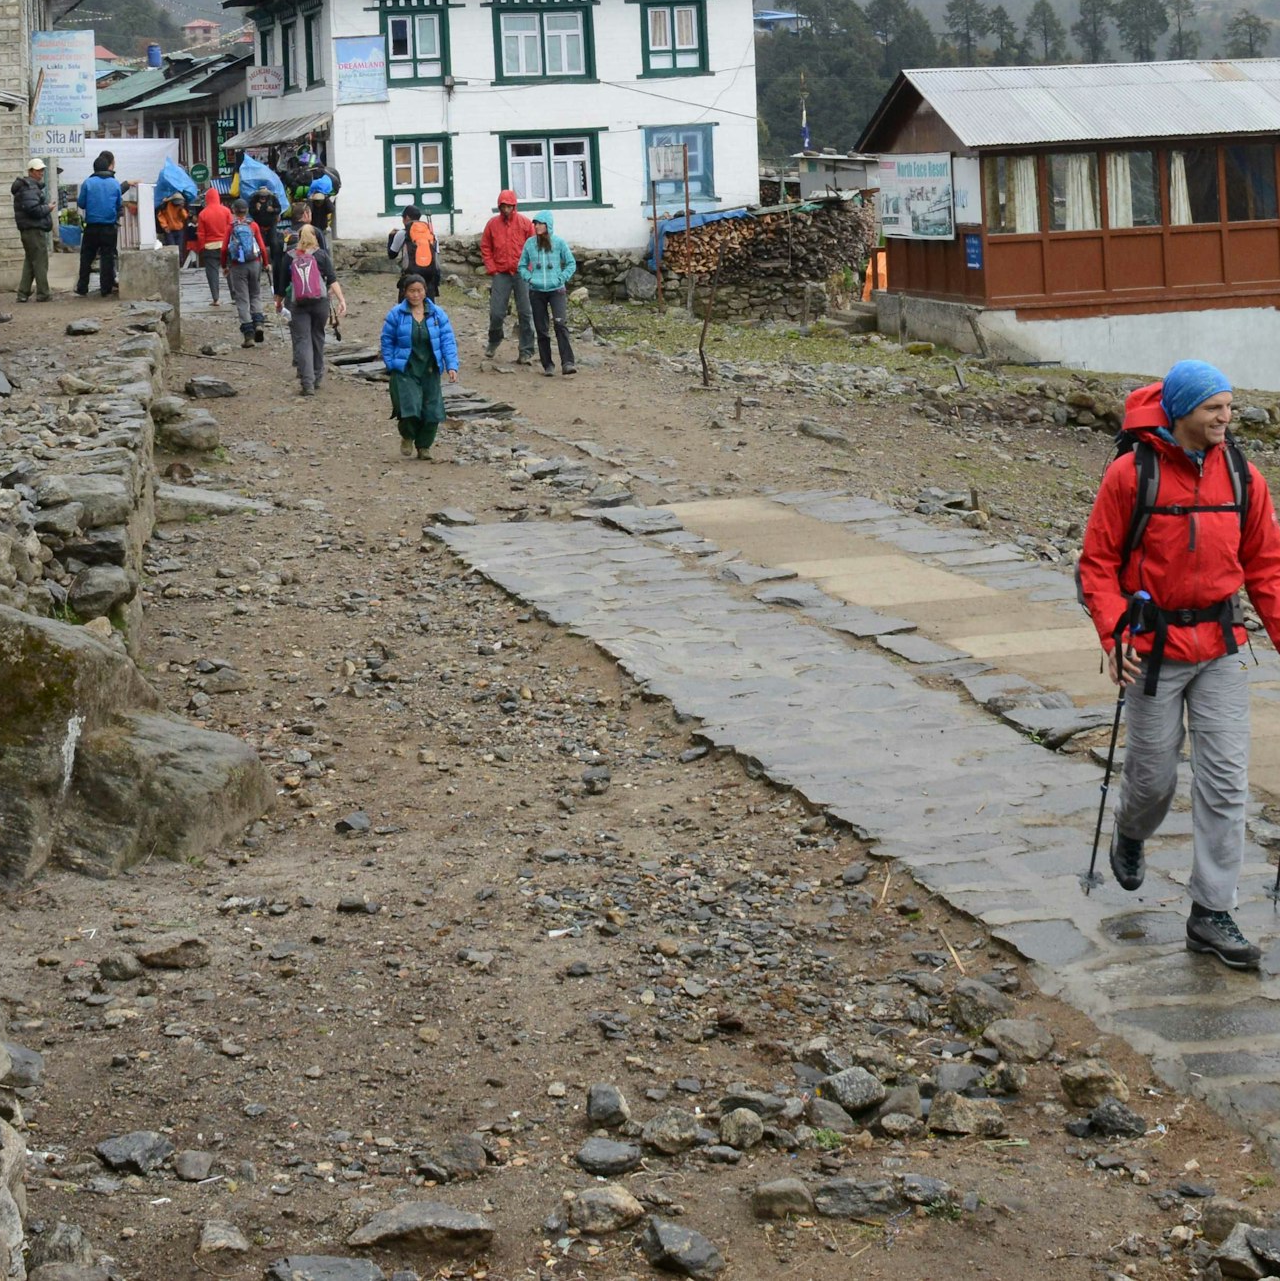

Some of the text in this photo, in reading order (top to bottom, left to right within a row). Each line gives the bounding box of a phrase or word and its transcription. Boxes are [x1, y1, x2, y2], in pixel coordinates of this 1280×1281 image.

[338, 62, 384, 70] DREAMLAND
[251, 83, 281, 91] RESTAURANT
[46, 130, 82, 144] Sita Air
[31, 146, 83, 154] SALES OFFICE LUKLA
[897, 162, 913, 177] North
[913, 161, 928, 177] Face
[928, 161, 948, 177] Resort
